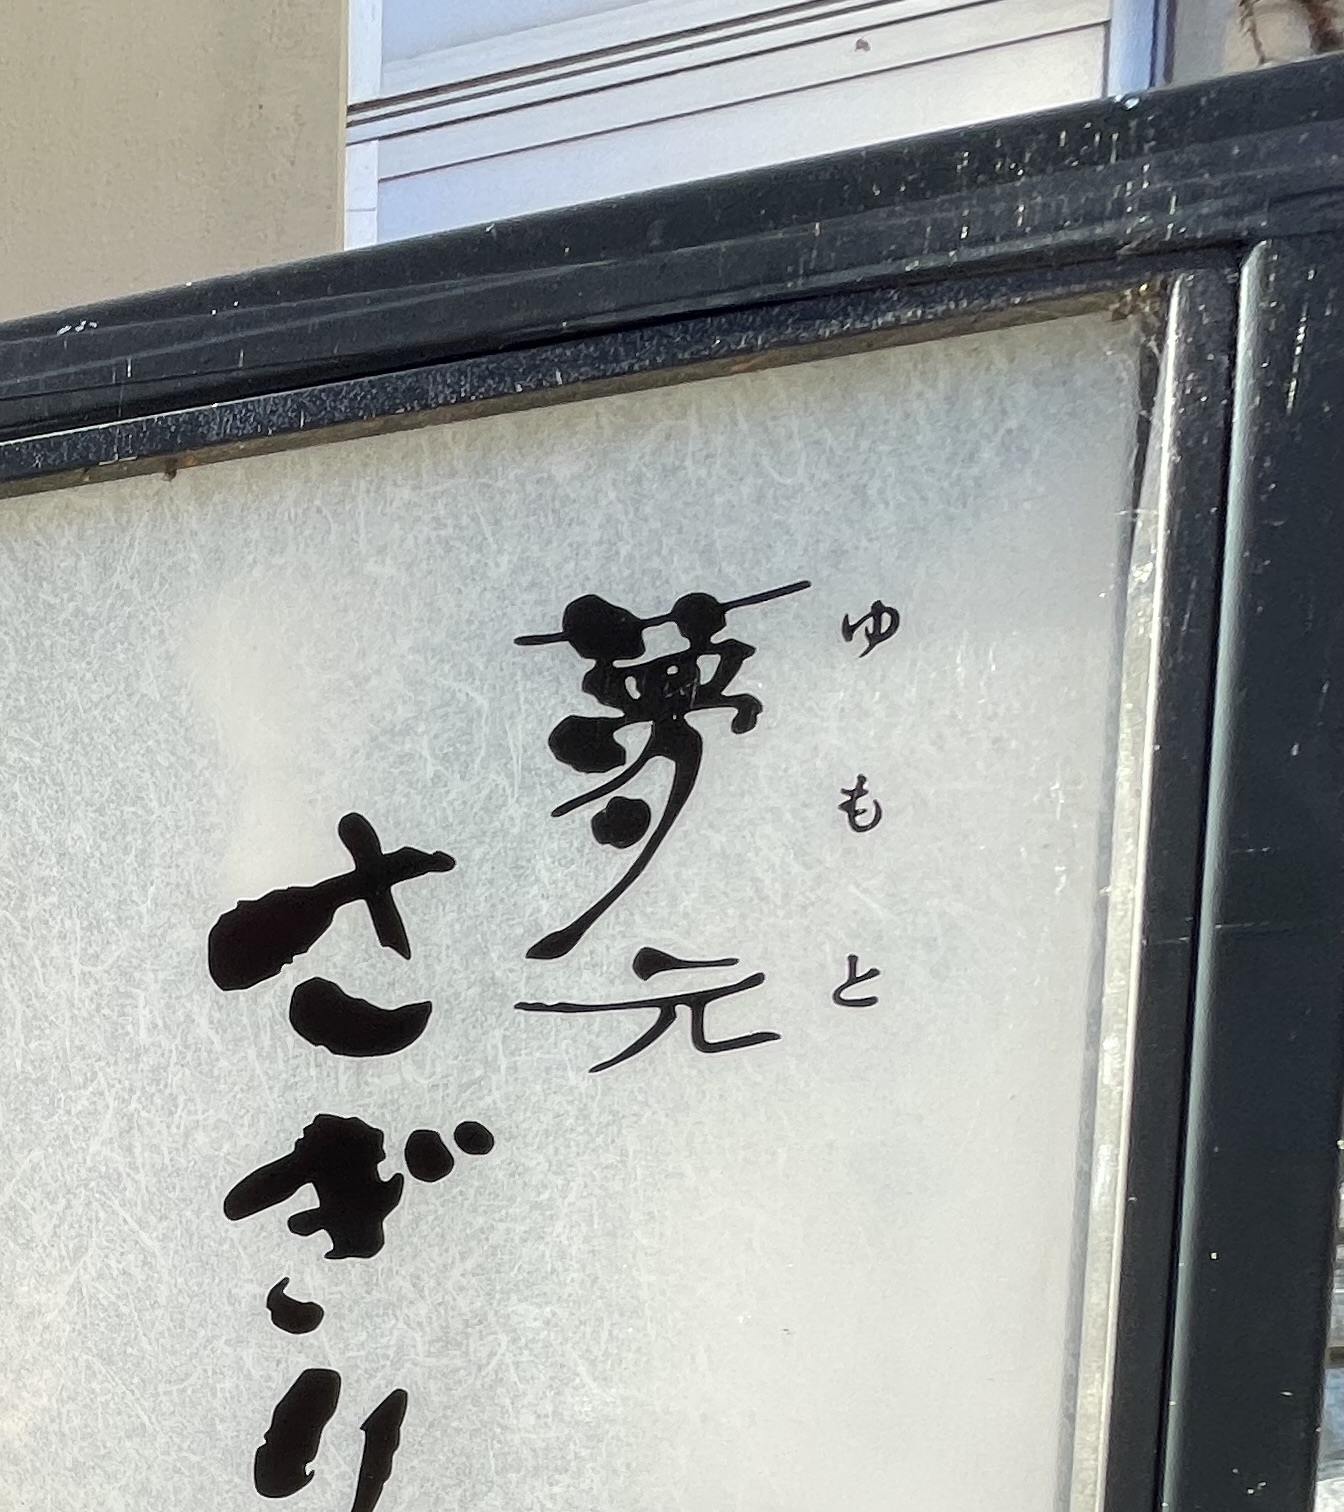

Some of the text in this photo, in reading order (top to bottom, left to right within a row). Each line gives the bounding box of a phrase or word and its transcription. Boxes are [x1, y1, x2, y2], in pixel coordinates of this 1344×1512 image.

[513, 581, 811, 1073] 夢元
[832, 600, 900, 1007] ゆもと
